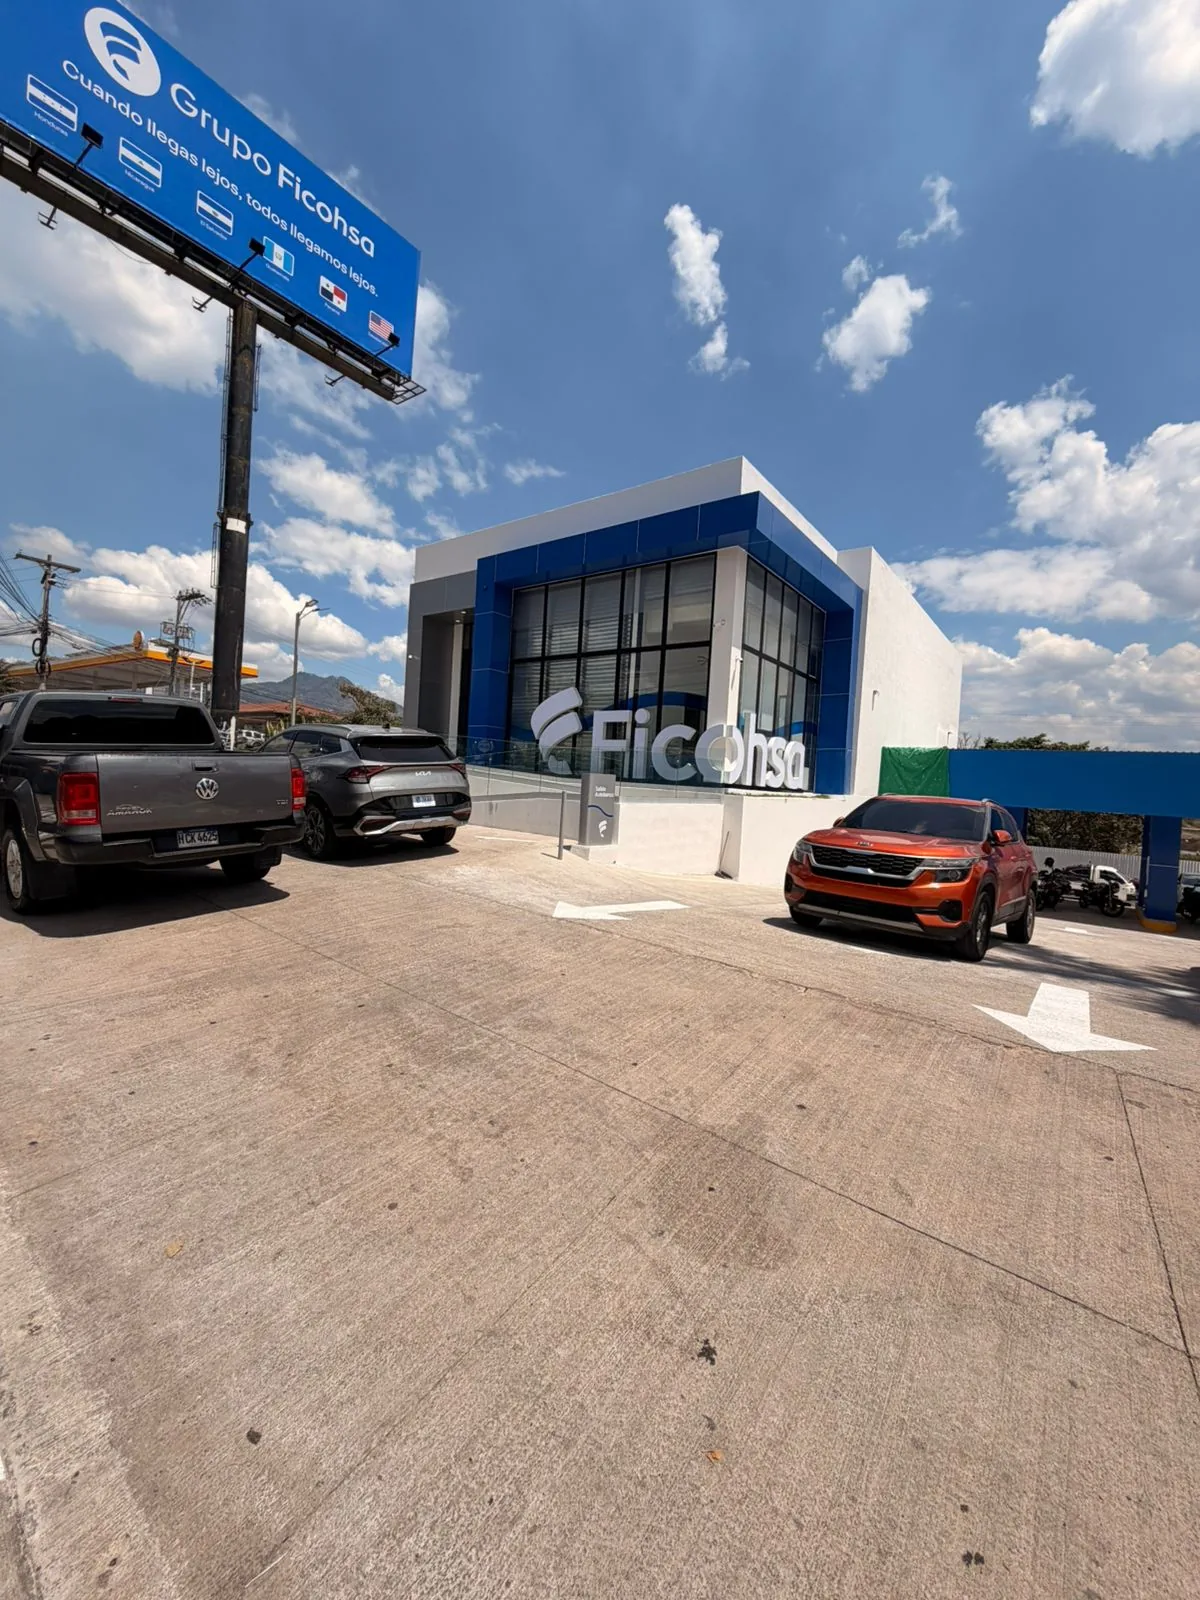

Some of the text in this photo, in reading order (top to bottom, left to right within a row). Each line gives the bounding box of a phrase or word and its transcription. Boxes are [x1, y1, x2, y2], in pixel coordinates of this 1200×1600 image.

[34, 111, 68, 137] Honduras
[62, 60, 378, 297] Cuando llegas lejos, todos llegamos lejos.
[170, 83, 375, 258] Grupo Ficohsa
[588, 708, 805, 790] Ficohsa
